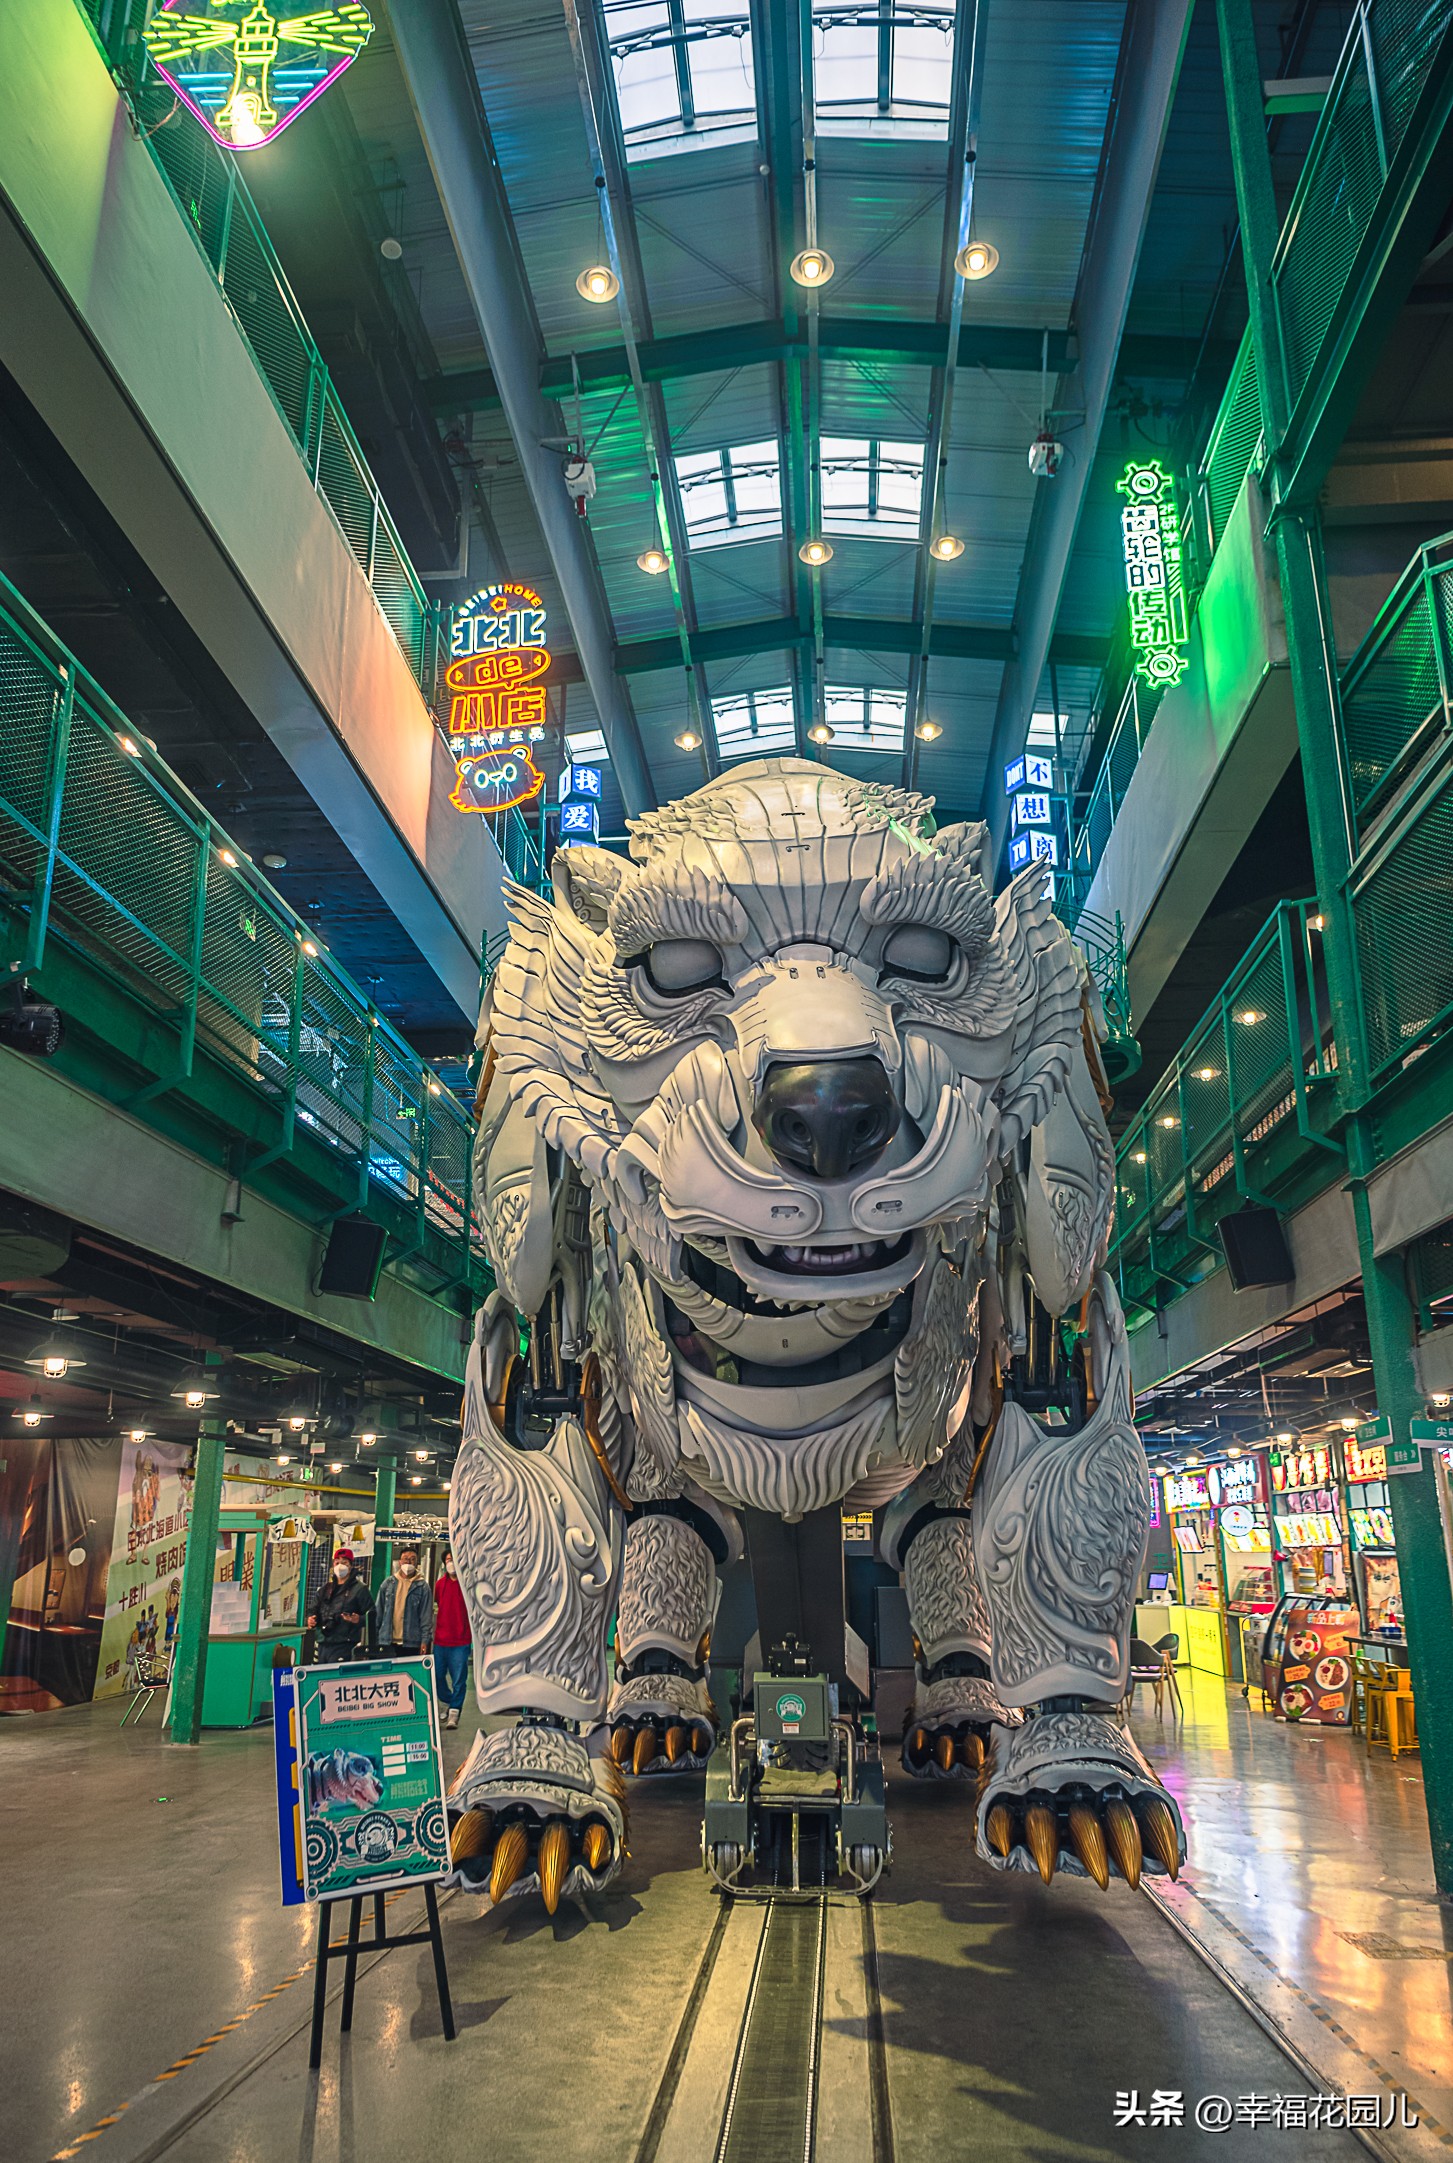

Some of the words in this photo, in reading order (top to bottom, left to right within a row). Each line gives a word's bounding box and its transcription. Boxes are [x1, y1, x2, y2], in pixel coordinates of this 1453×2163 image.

[1121, 504, 1170, 648] 齿轮的传动
[503, 583, 543, 608] HOME
[450, 608, 547, 658] 北北
[475, 655, 523, 686] de
[449, 686, 547, 735] 小店
[1012, 840, 1027, 862] TO
[334, 1681, 400, 1703] 北北大秀
[337, 1704, 360, 1713] BEIBEI
[377, 1699, 399, 1709] SHOW
[381, 1735, 402, 1743] TIME
